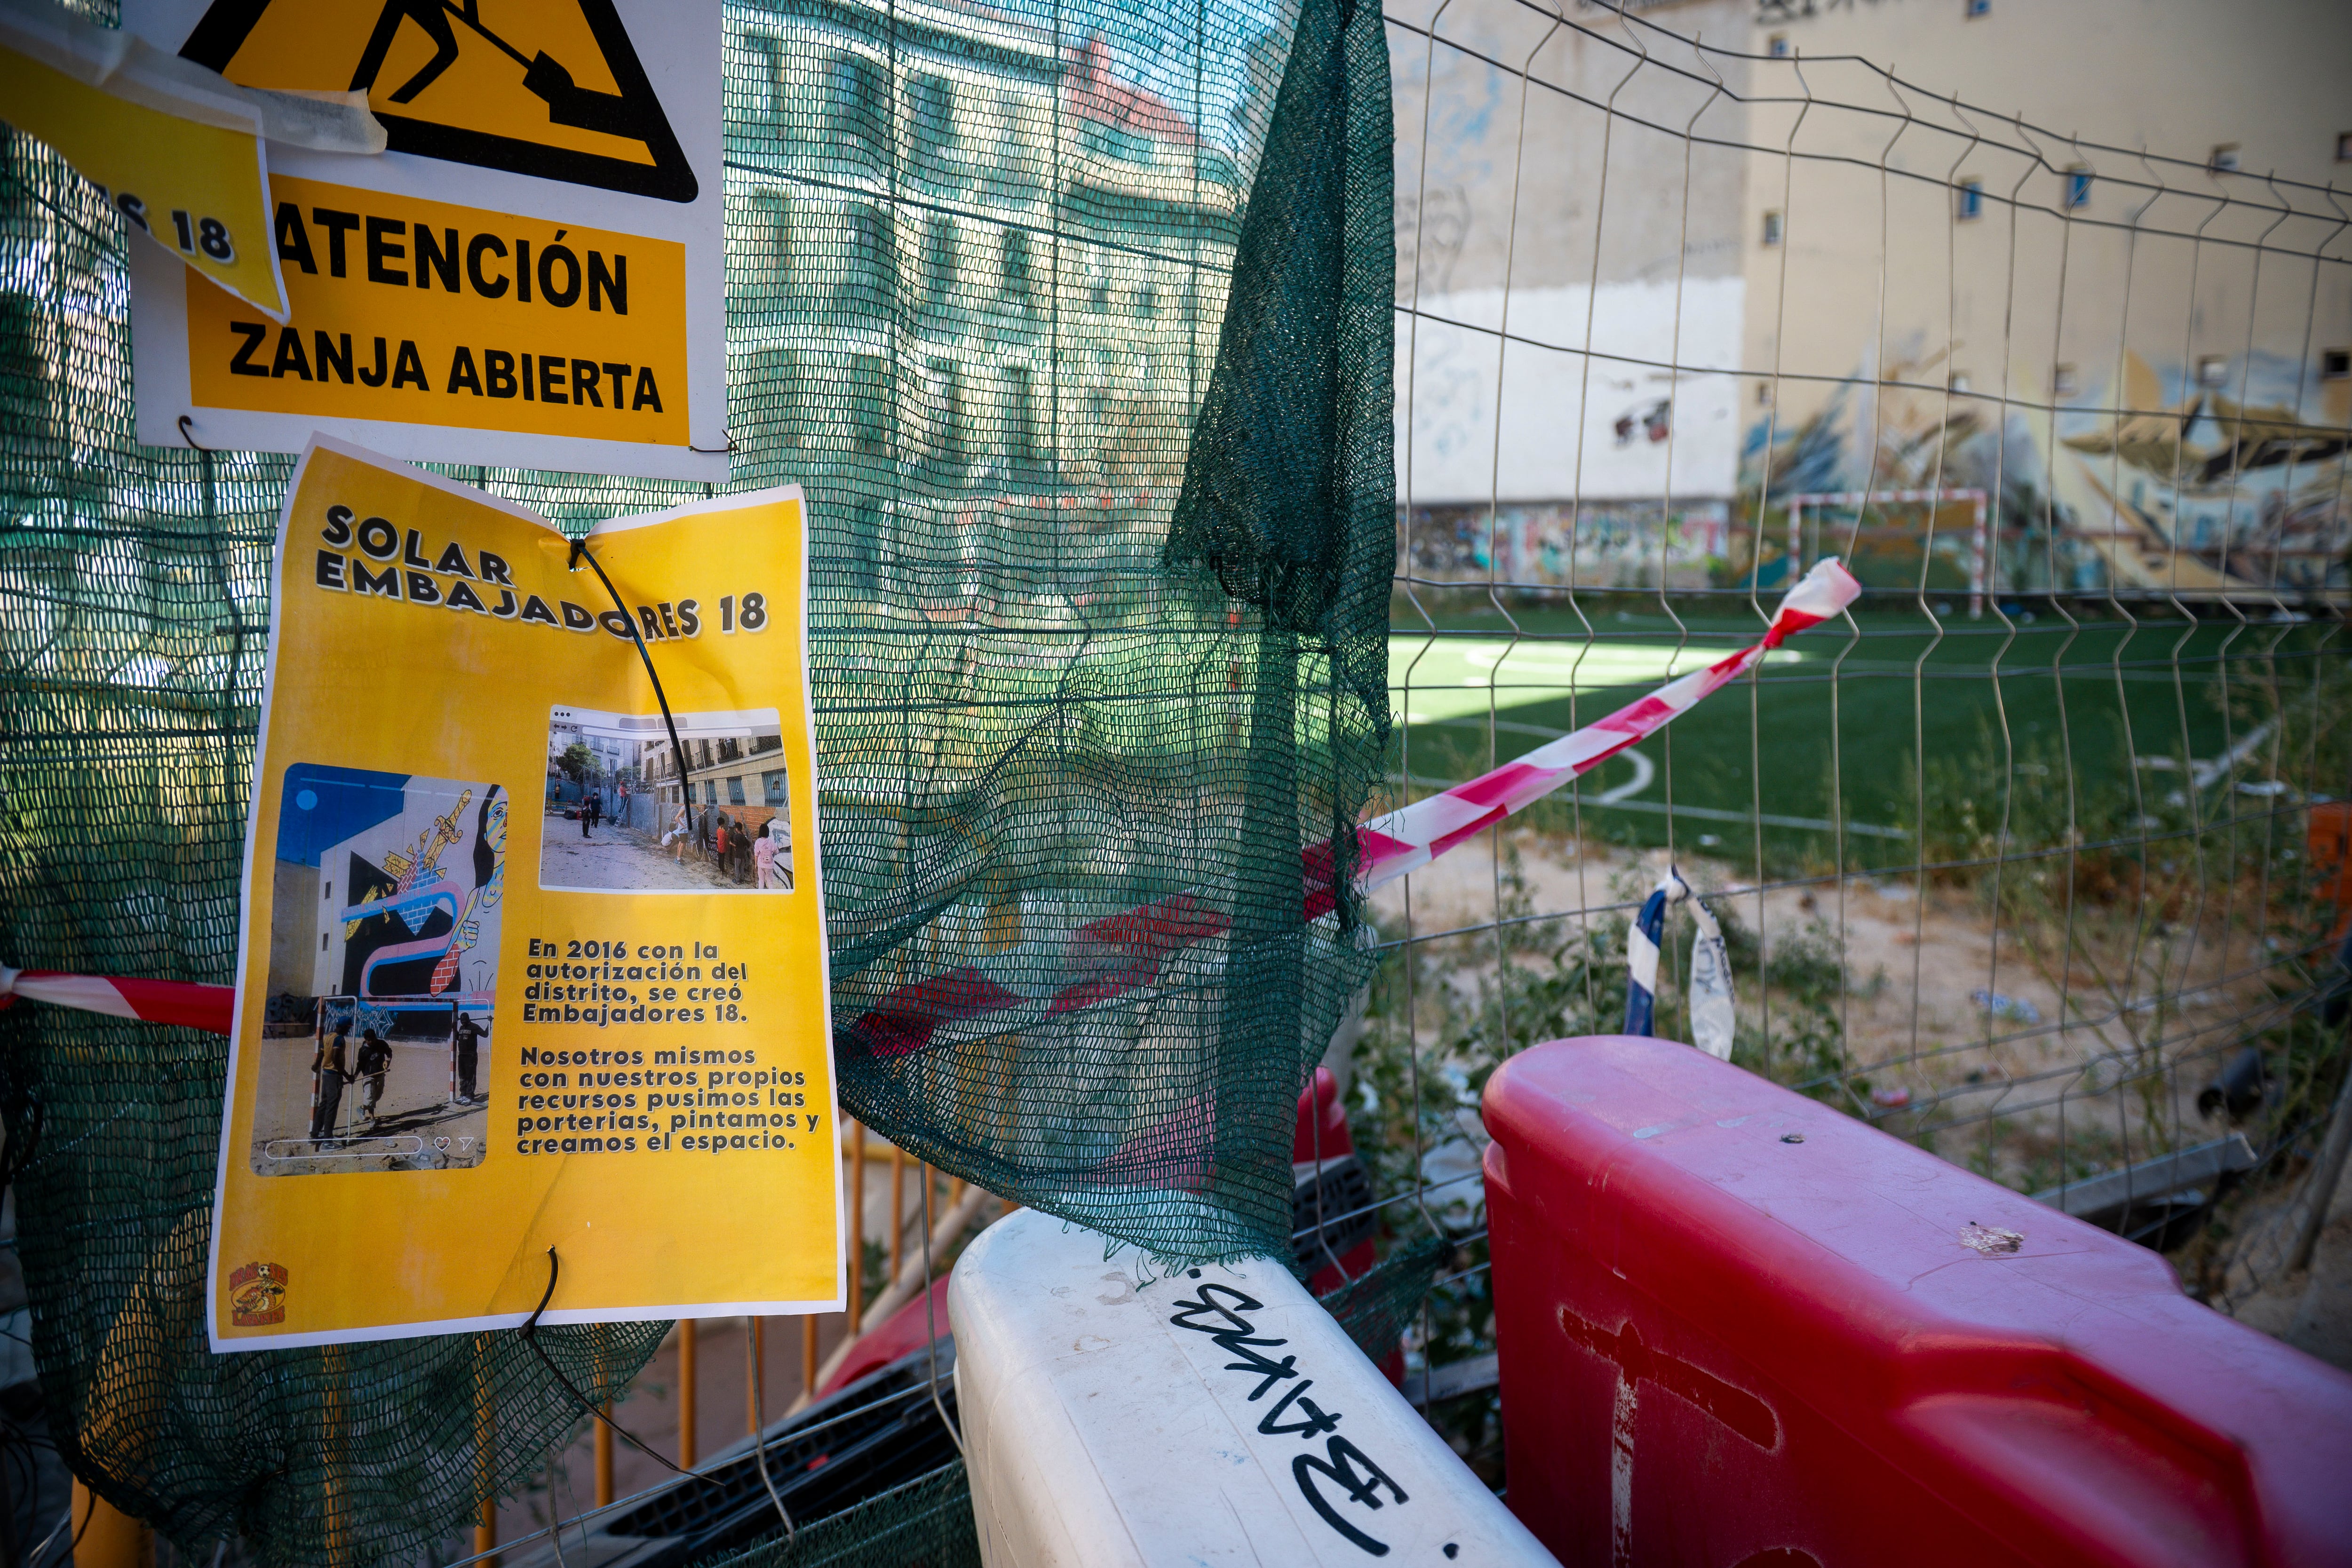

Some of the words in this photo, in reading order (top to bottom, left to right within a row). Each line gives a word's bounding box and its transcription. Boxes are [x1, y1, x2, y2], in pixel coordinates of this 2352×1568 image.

[171, 209, 235, 265] 18
[275, 201, 628, 316] ATENCIÓN
[230, 321, 429, 391] ZANJA
[447, 346, 663, 413] ABIERTA
[321, 504, 516, 588] SOLAR
[316, 549, 700, 643] EMBAJADORES
[719, 592, 769, 635] 18
[529, 938, 556, 959] En
[567, 940, 628, 960] 2016
[637, 942, 684, 960] con
[694, 941, 718, 960] la
[526, 961, 701, 981] autorización
[712, 963, 748, 981] del
[524, 982, 637, 1005] distrito,
[649, 986, 677, 1002] se
[687, 983, 742, 1002] creó
[523, 1003, 706, 1027] Embajadores
[715, 1004, 748, 1022] 18.
[521, 1047, 644, 1067] Nosotros
[654, 1045, 756, 1065] mismos
[520, 1069, 567, 1089] con
[579, 1069, 699, 1087] nuestros
[708, 1067, 806, 1090] propios
[518, 1091, 636, 1110] recursos
[647, 1088, 760, 1113] pusimos
[770, 1088, 806, 1107] las
[517, 1111, 659, 1136] porterias,
[670, 1110, 797, 1133] pintamos
[806, 1114, 820, 1133] y
[517, 1133, 636, 1154] creamos
[647, 1132, 671, 1151] el
[681, 1130, 795, 1154] espacio.
